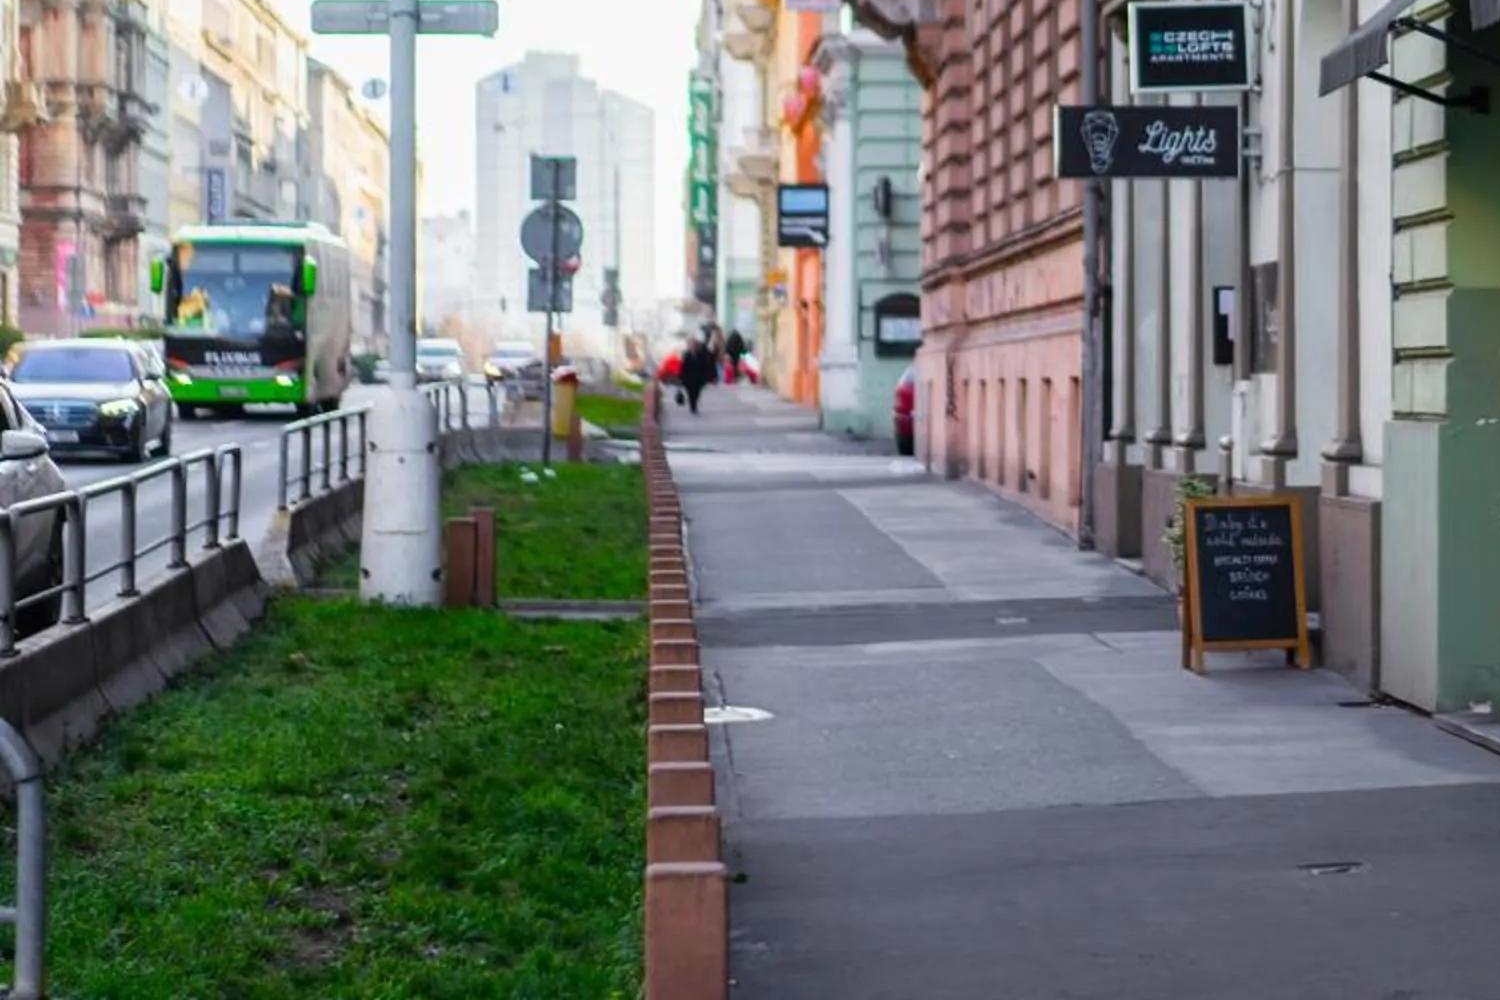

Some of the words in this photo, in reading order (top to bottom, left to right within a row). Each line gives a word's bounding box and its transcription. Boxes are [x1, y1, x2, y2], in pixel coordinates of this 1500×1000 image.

[1164, 30, 1234, 43] CZECH
[1177, 42, 1234, 53] LOFTS
[1150, 53, 1234, 62] APARTMENTS
[1137, 119, 1217, 164] Lights
